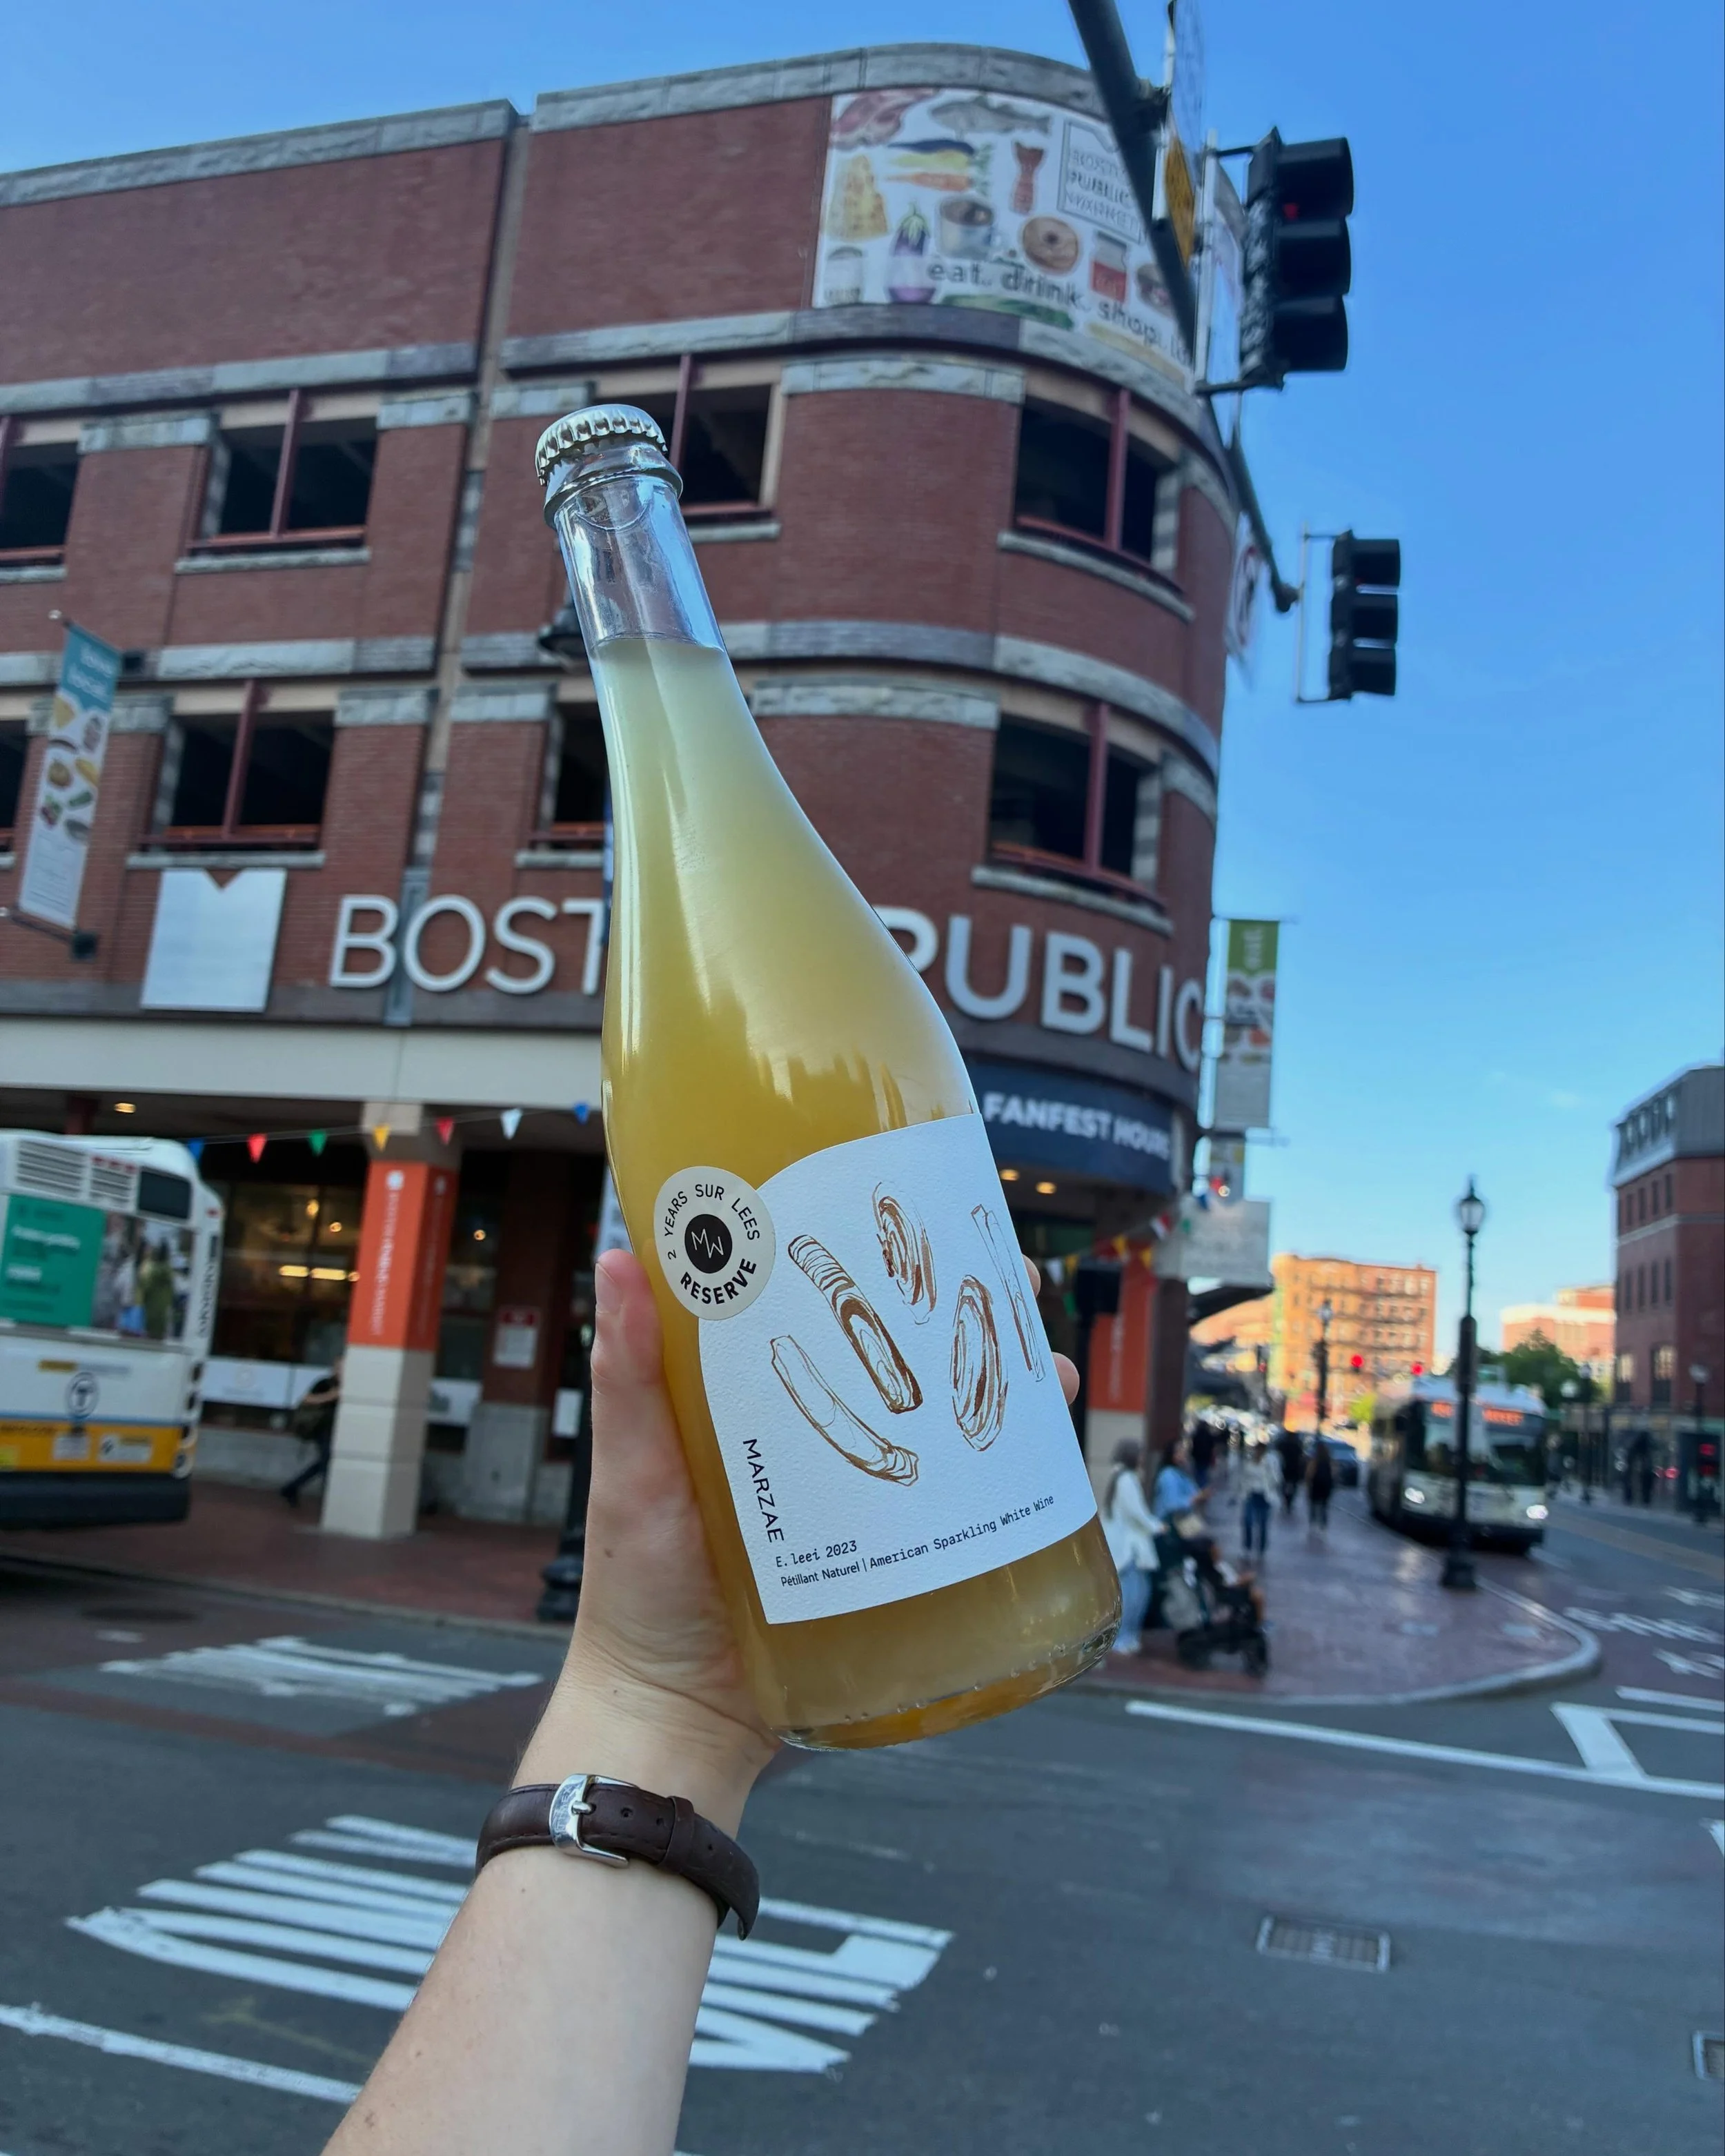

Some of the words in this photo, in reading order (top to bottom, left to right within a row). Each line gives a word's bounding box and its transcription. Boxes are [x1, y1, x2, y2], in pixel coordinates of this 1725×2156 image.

[1070, 171, 1133, 208] PUBLIC
[329, 893, 604, 994] BOST
[872, 904, 1203, 1073] PUBLIC
[983, 1091, 1111, 1140] FANFEST
[664, 1191, 688, 1237] YEARS
[695, 1184, 724, 1200] SUR
[731, 1198, 760, 1240] LEES
[667, 1249, 677, 1260] 2
[680, 1258, 756, 1305] RESERVE
[742, 1438, 785, 1543] MARZAE
[776, 1556, 787, 1567] E.
[791, 1549, 820, 1565] leei
[826, 1540, 857, 1558] 2023
[780, 1572, 819, 1587] Pétillant
[822, 1561, 860, 1580] Naturel
[870, 1543, 929, 1569] American
[934, 1520, 997, 1550] Sparkling
[1000, 1507, 1031, 1526] White
[1033, 1495, 1054, 1511] Wine
